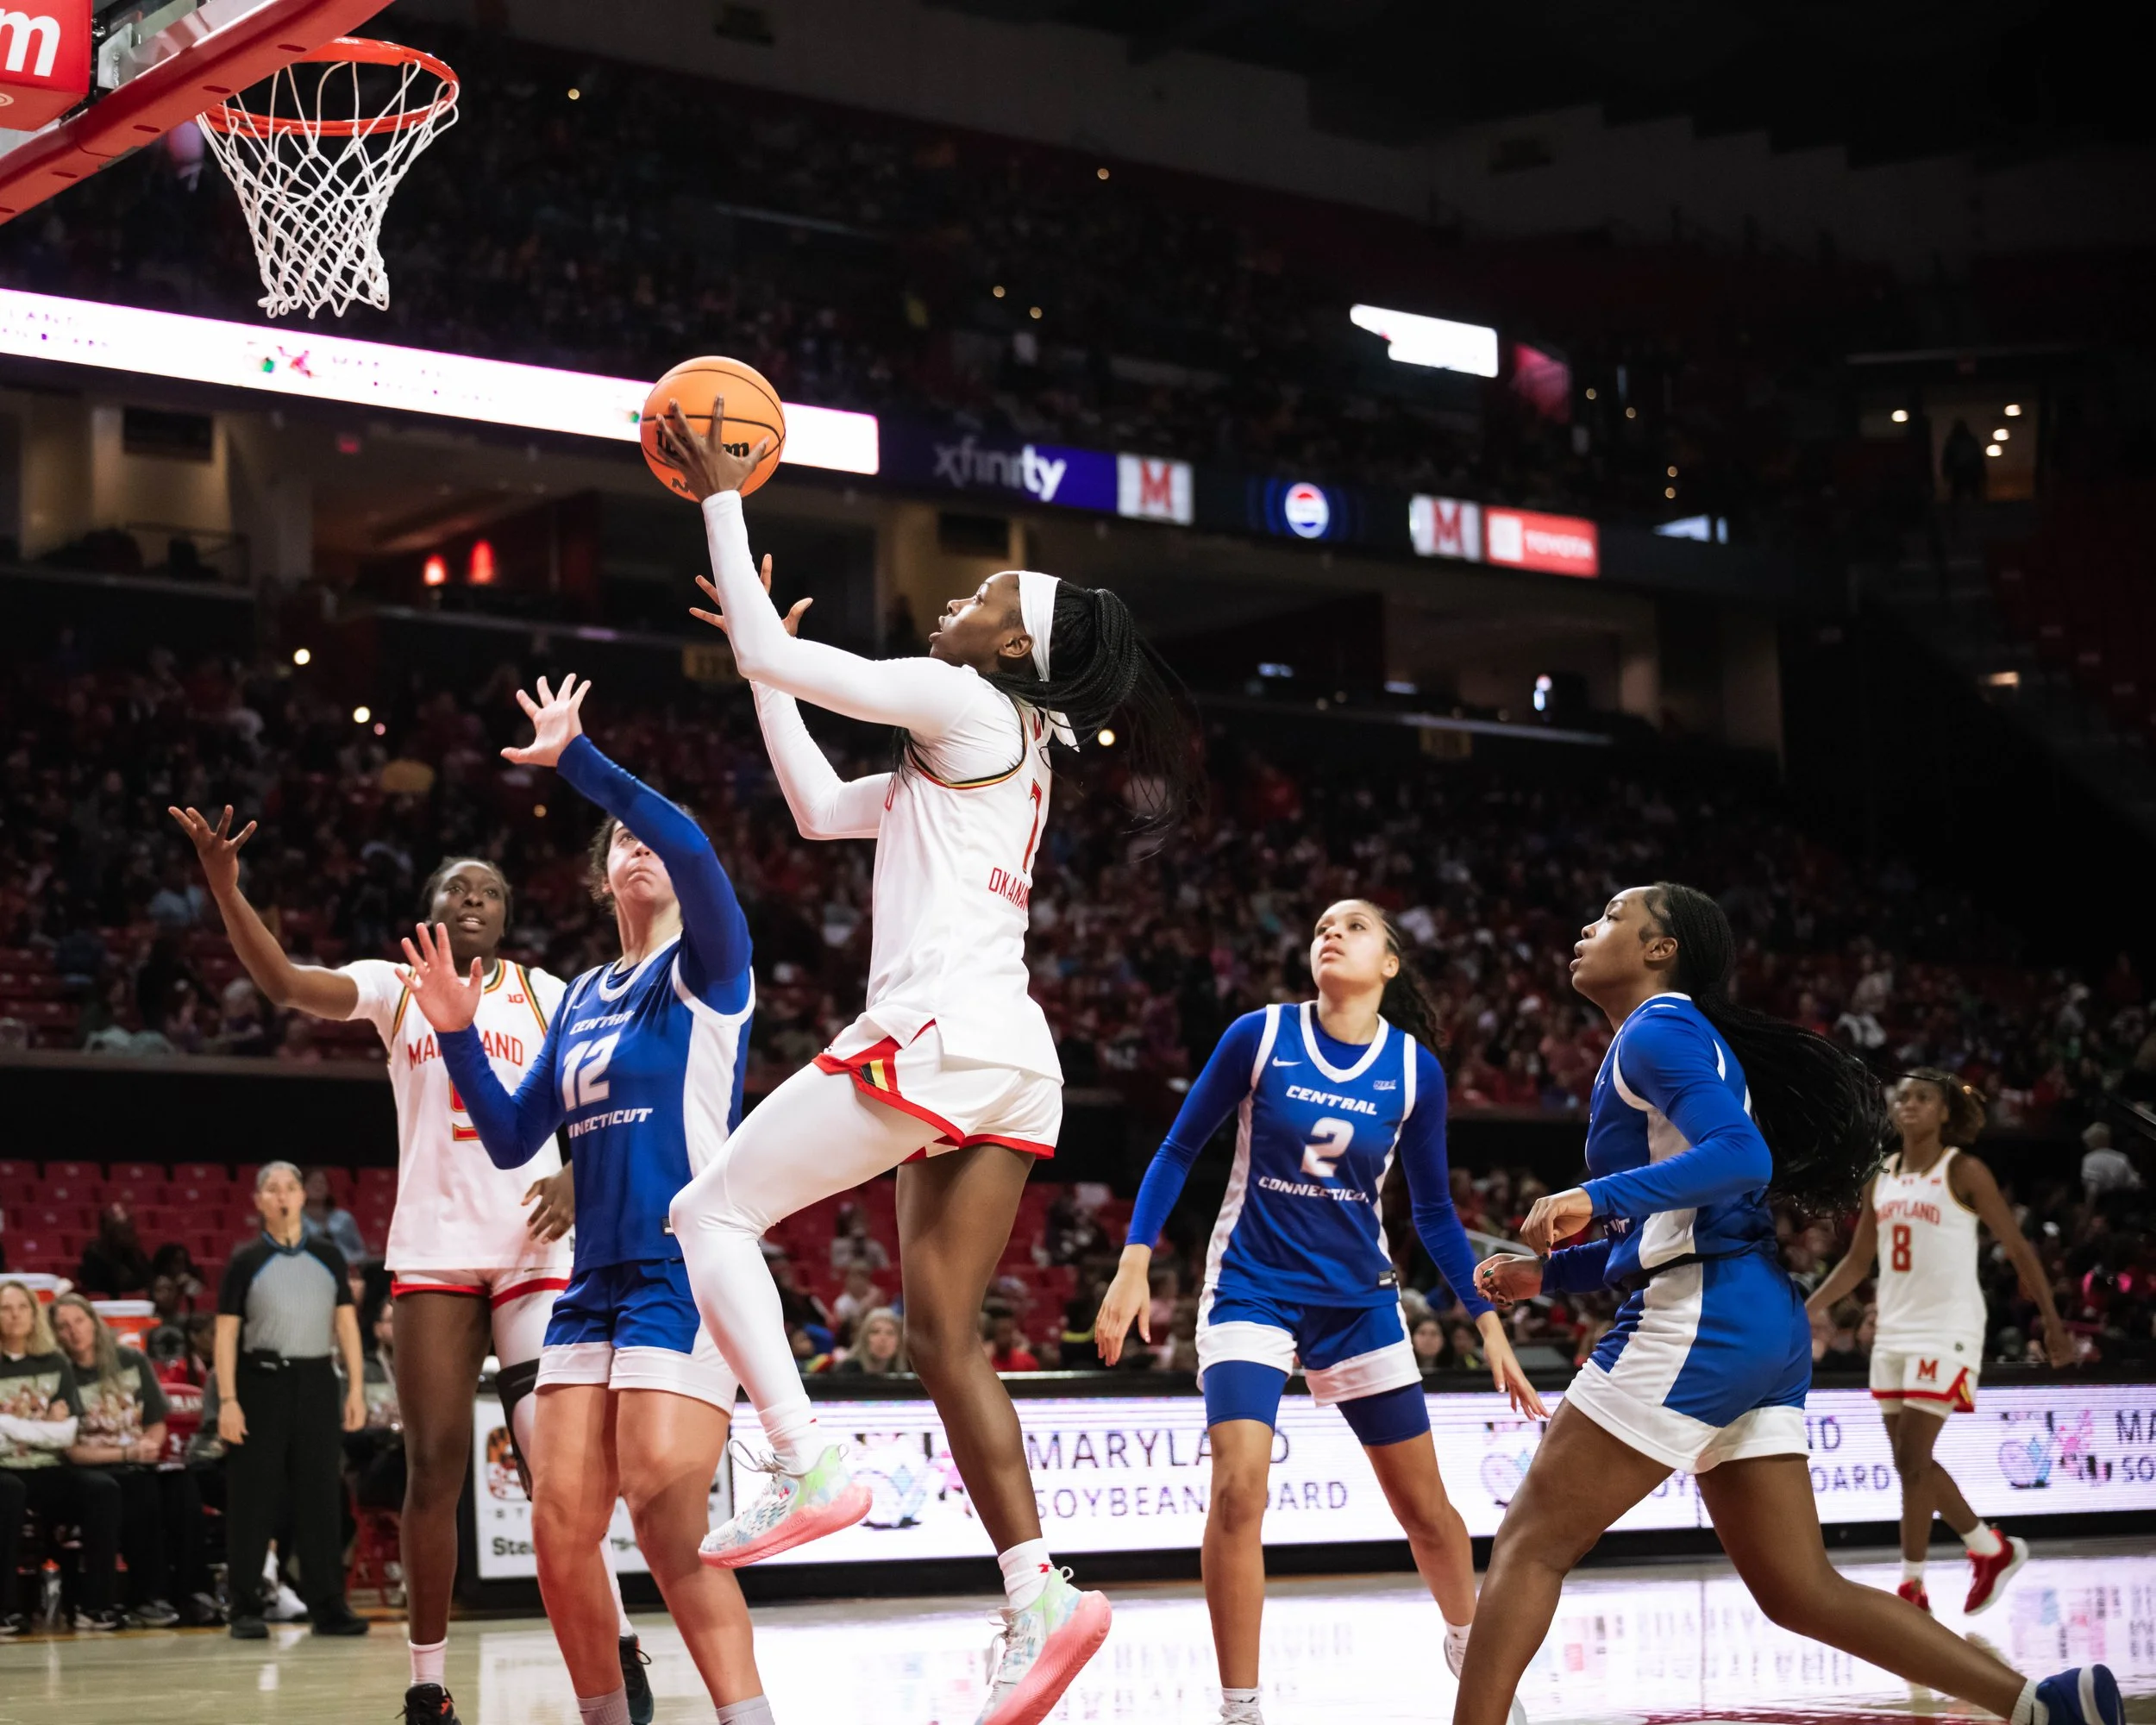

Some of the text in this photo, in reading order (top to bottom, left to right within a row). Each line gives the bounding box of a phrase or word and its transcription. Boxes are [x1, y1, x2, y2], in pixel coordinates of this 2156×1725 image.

[408, 1030, 523, 1071] MAAND
[561, 1032, 621, 1112] 12
[1286, 1085, 1377, 1116] CENTRAL
[567, 1107, 654, 1138] NECTICUT
[1300, 1117, 1355, 1177] 2
[1892, 1224, 1912, 1272] 8
[1917, 1358, 1940, 1380] M
[1027, 1429, 1289, 1470] MARYLAD
[1810, 1465, 1891, 1493] OARD
[1035, 1481, 1348, 1520] SOYBEAN ARD
